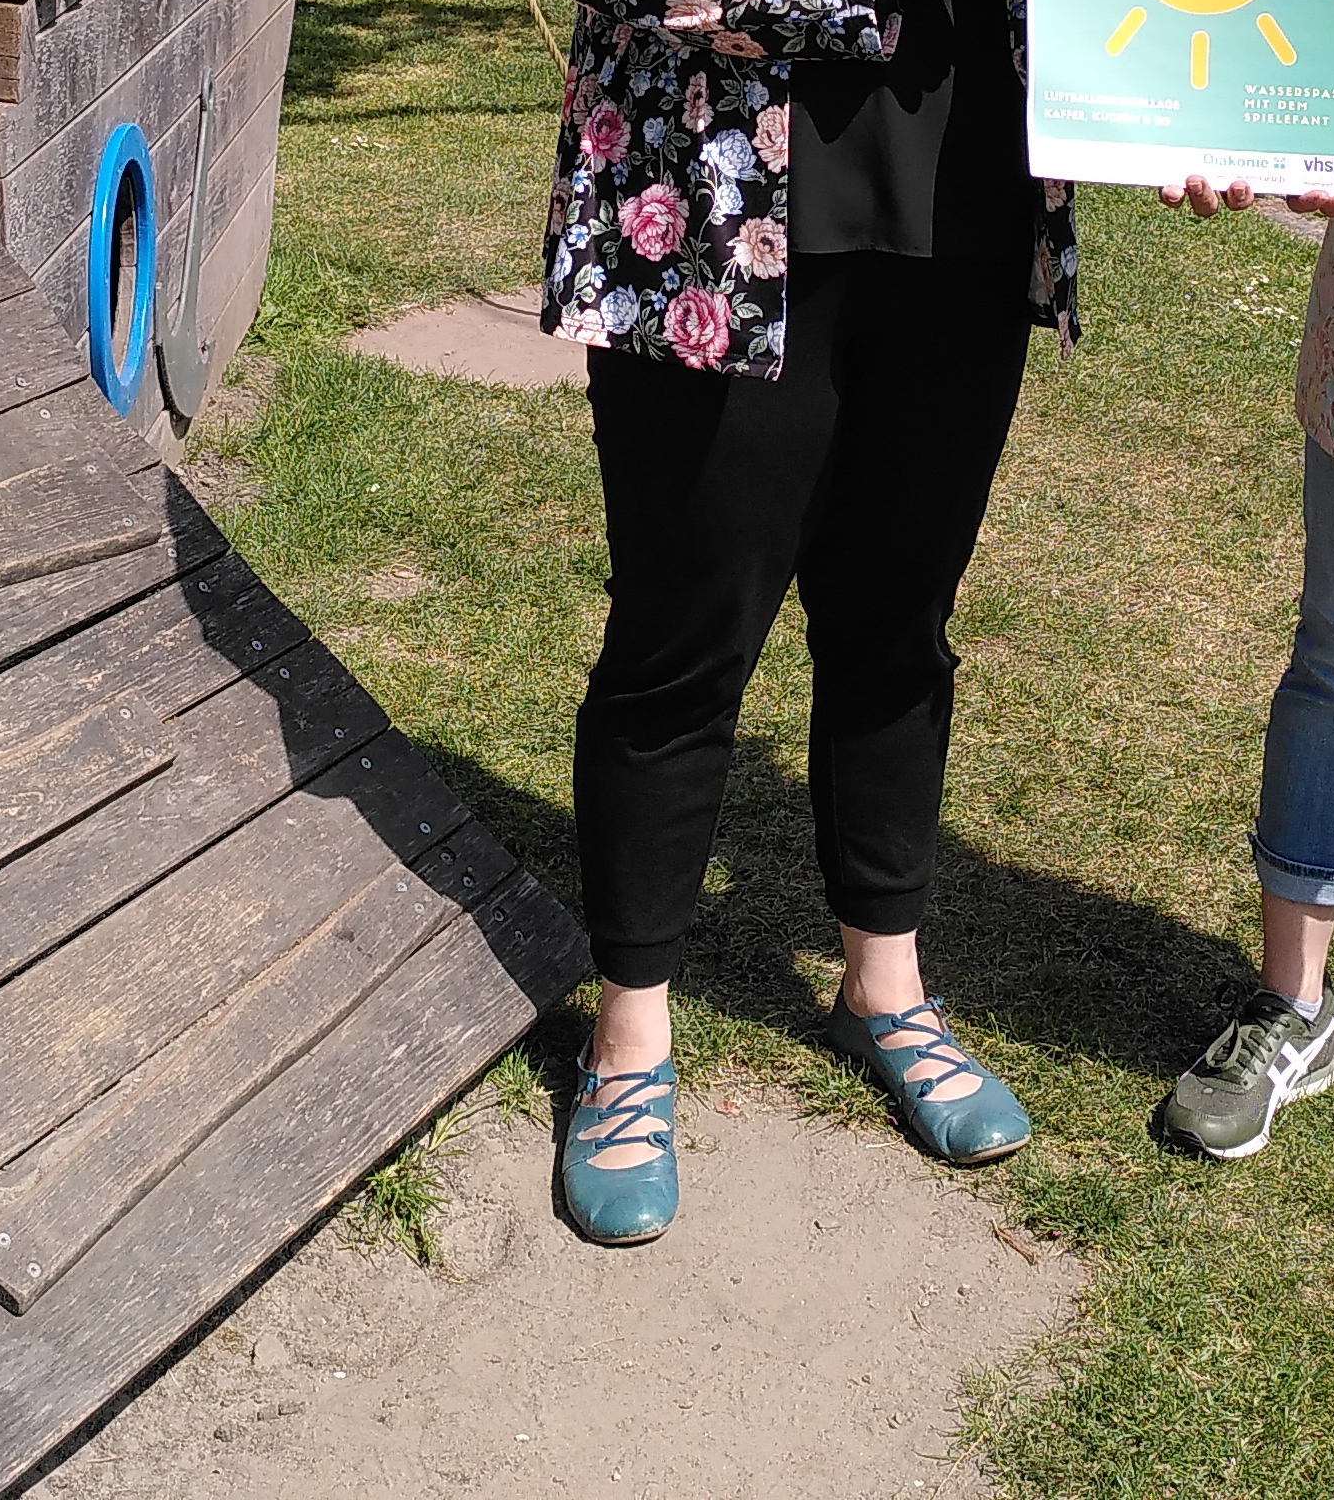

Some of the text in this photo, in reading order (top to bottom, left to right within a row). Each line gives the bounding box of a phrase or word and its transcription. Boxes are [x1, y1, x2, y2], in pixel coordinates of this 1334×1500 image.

[1244, 99, 1308, 111] MIT DEM
[1244, 112, 1330, 126] SPIELEFANT
[1203, 153, 1269, 169] Diakonie
[1304, 157, 1334, 172] vhs
